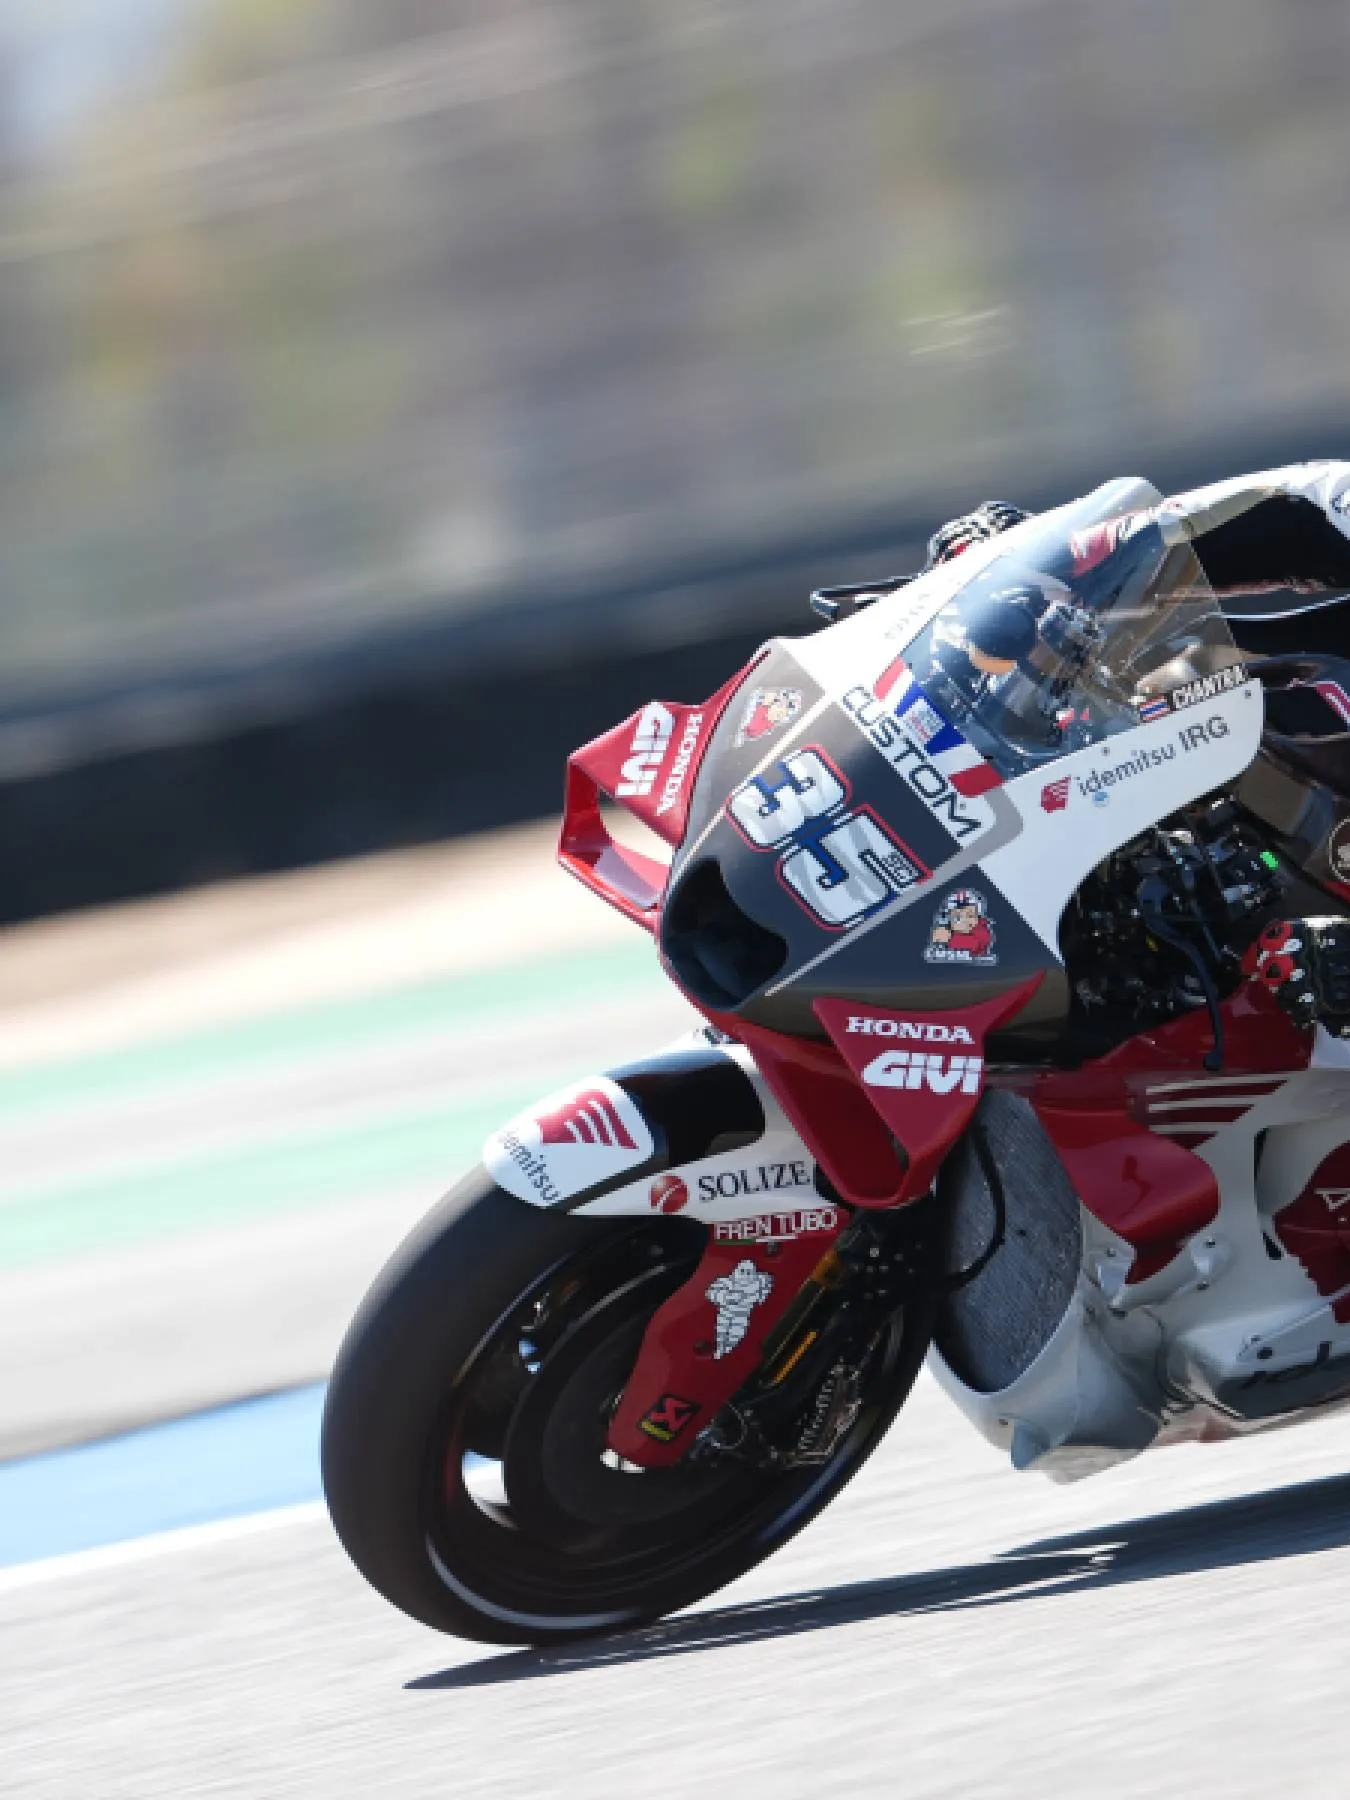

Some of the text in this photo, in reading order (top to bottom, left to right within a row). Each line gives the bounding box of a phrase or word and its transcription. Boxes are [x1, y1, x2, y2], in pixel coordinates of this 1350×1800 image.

[615, 701, 676, 798] GIVI
[656, 713, 702, 816] HONDA
[843, 686, 981, 838] CUSTOM
[1076, 716, 1230, 796] idemitsu IRG
[727, 744, 930, 931] 35
[845, 1016, 975, 1045] HONDA
[860, 1049, 983, 1095] GIVI
[500, 1128, 560, 1201] emitsu
[697, 1160, 812, 1202] SOLIZE
[713, 1208, 837, 1242] FREN TUBO
